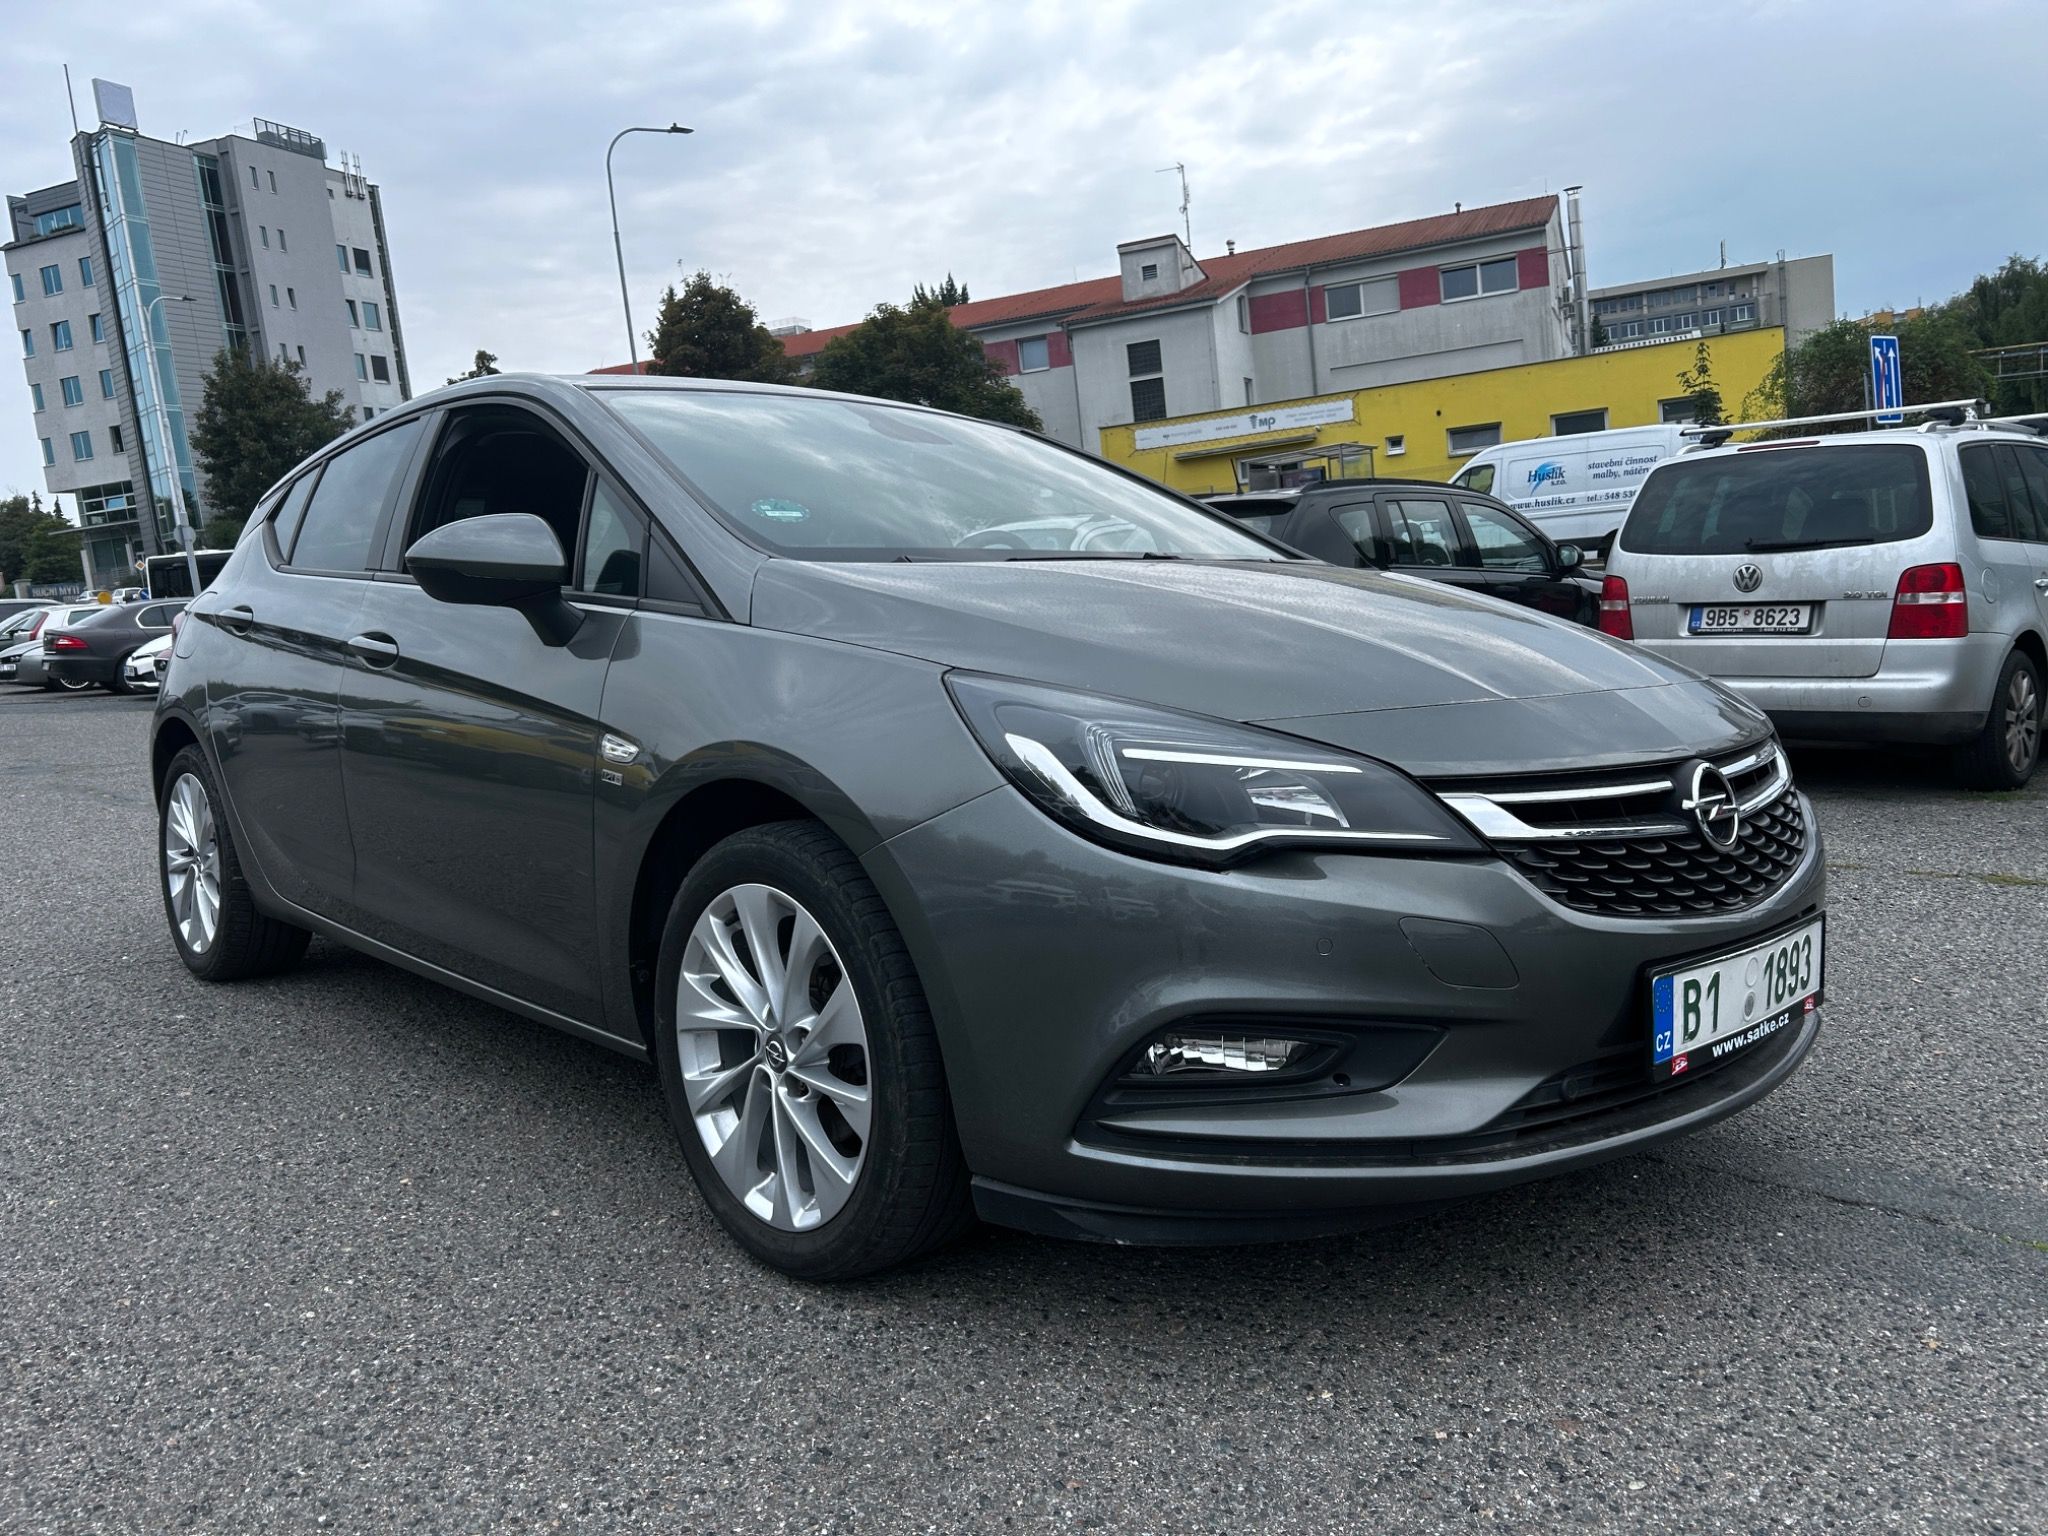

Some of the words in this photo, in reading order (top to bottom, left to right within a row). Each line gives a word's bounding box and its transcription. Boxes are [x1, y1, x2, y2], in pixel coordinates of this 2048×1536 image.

[1587, 457, 1624, 470] stavební
[1625, 455, 1658, 468] činnost
[1592, 468, 1621, 480] malby,
[1586, 494, 1602, 502] tel.:
[1603, 492, 1621, 501] 548
[1705, 609, 1740, 627] 9B5
[1753, 608, 1801, 626] 8623
[1682, 970, 1721, 1044] B1
[1763, 934, 1812, 1010] 1893
[1655, 1030, 1672, 1053] CZ
[1711, 1012, 1791, 1058] www.satke.cz
